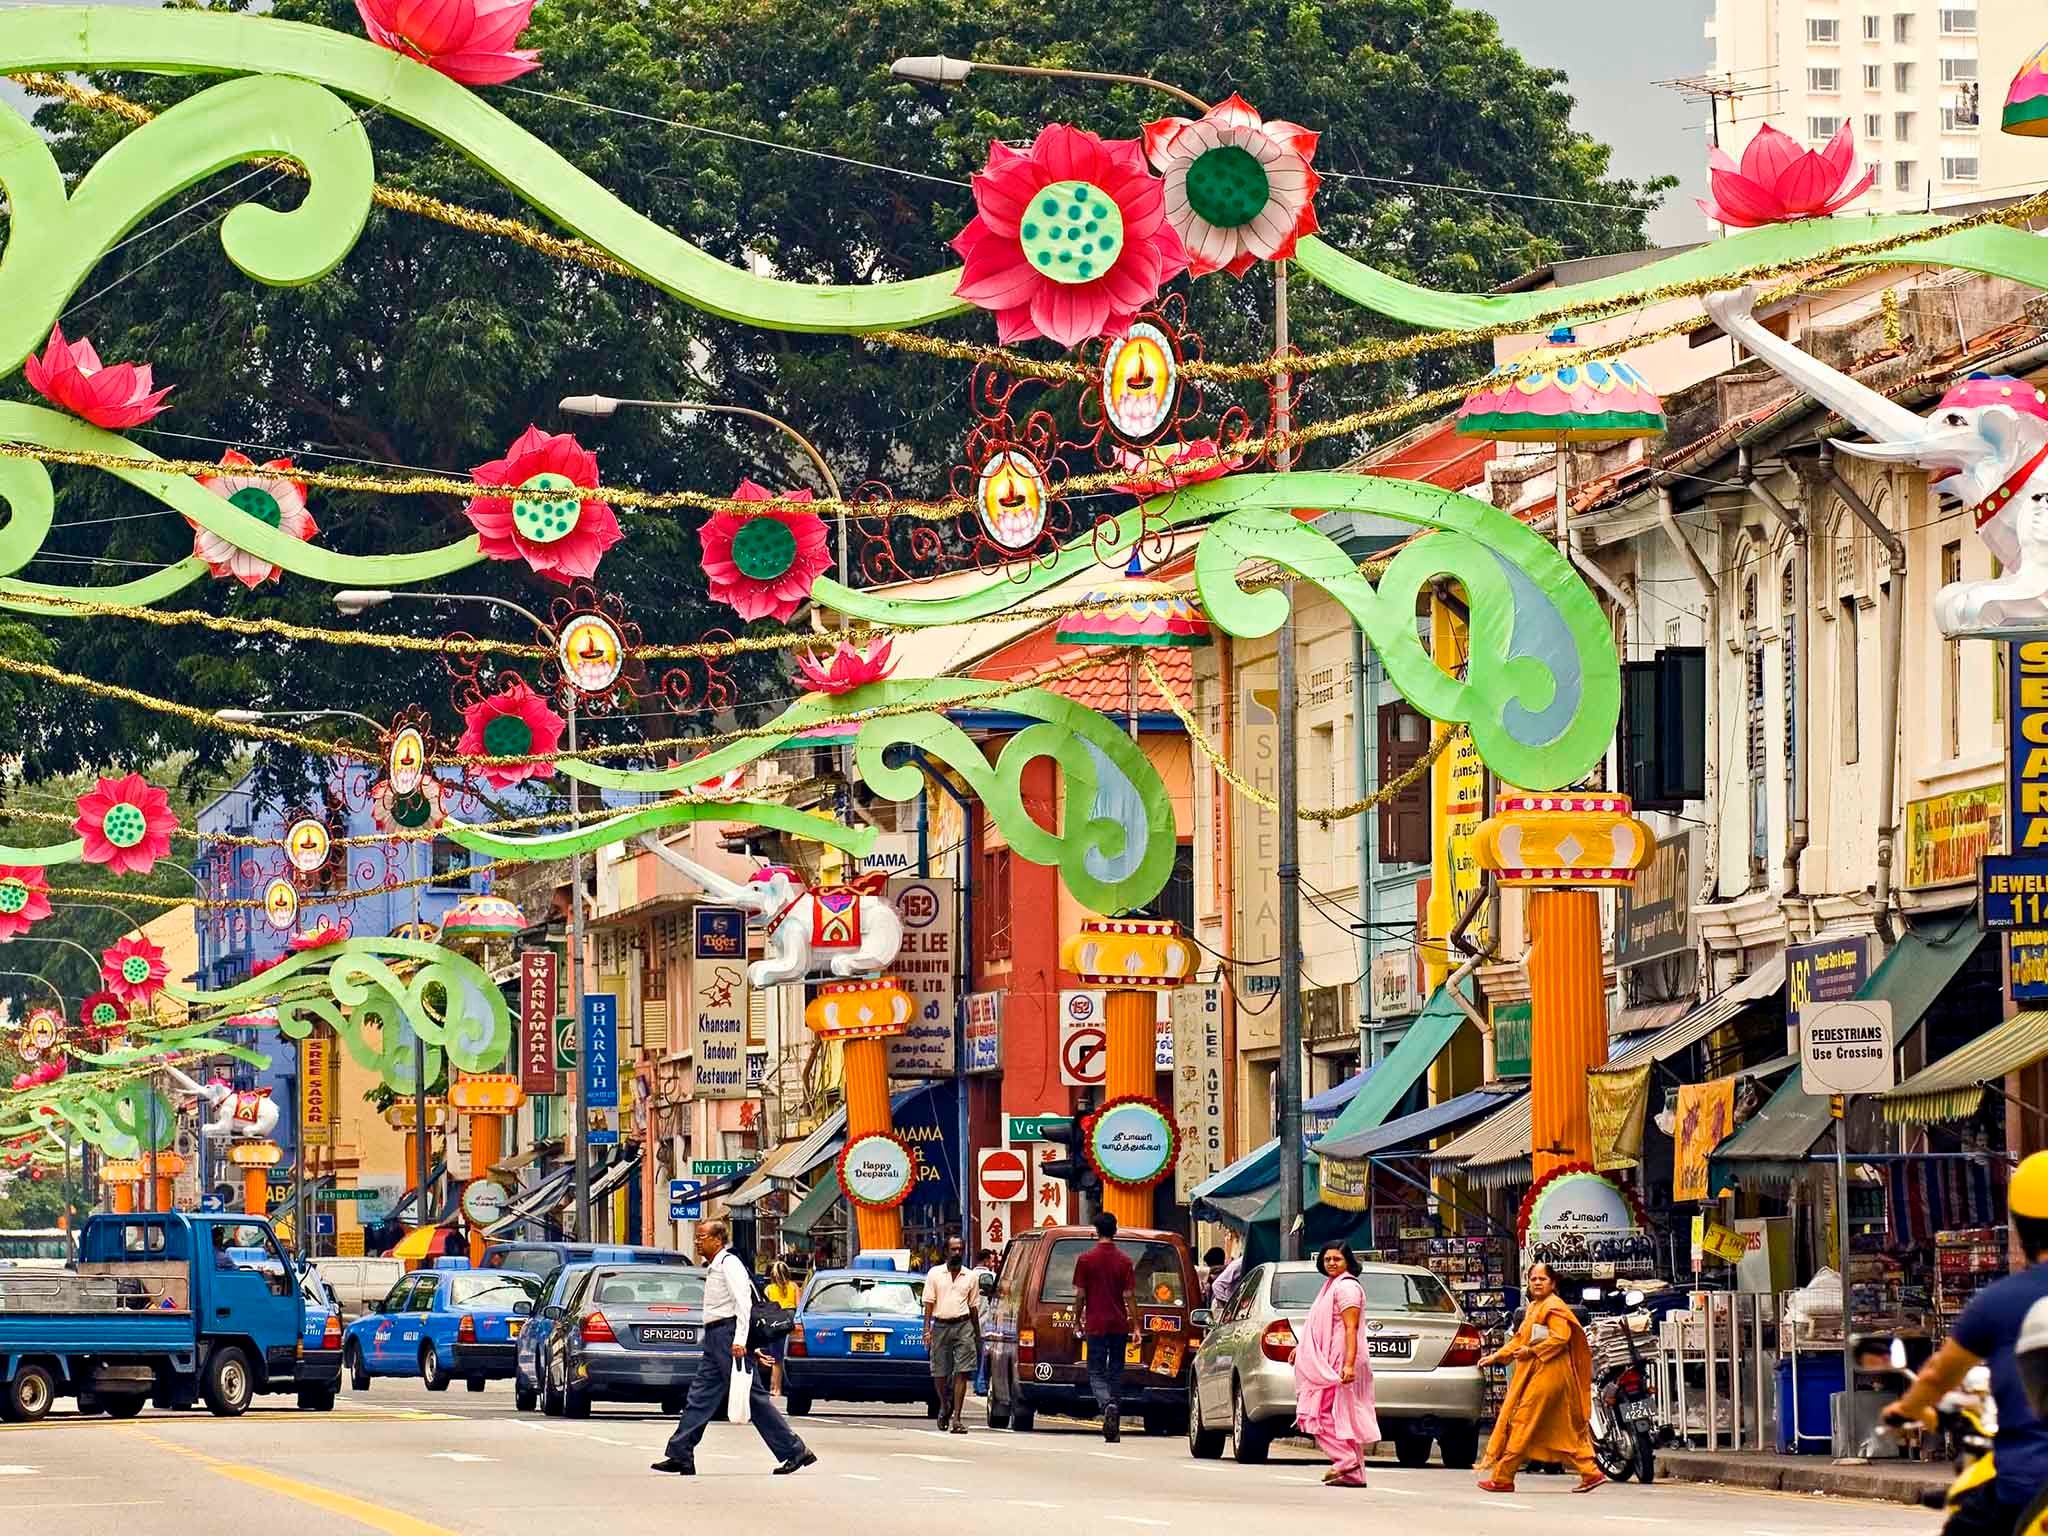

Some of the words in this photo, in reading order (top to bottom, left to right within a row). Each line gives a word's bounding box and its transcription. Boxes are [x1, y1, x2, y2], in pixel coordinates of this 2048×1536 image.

[1255, 735, 1277, 958] SHEETAL
[863, 854, 907, 867] MAMA
[1989, 875, 2048, 893] JEWEL
[902, 895, 932, 916] 152
[703, 934, 737, 951] Tiger
[922, 932, 948, 952] LEE
[923, 980, 946, 992] LTD.
[1790, 959, 1811, 1013] ABC
[1072, 1001, 1090, 1014] 152
[1205, 990, 1217, 1012] HO
[528, 957, 549, 1073] SWARNAMAHAL
[699, 1013, 741, 1032] Khansama
[1206, 1024, 1217, 1056] LEE
[1811, 1027, 1882, 1041] PEDESTRIANS
[592, 1002, 606, 1088] BHARATH
[703, 1040, 737, 1060] Tandoori
[1813, 1048, 1832, 1060] Use
[1836, 1046, 1883, 1059] Crossing
[309, 1042, 322, 1075] SREE
[697, 1065, 741, 1085] Restaurant
[1207, 1069, 1219, 1115] AUTO
[308, 1080, 323, 1123] SAGAR
[894, 1126, 944, 1141] MAMA
[913, 1146, 926, 1162] &
[695, 1163, 732, 1174] Norris
[855, 1169, 899, 1178] Deepavali
[863, 1161, 892, 1170] Happy
[916, 1166, 940, 1181] PA
[672, 1207, 685, 1215] ONE
[687, 1207, 699, 1215] WAY
[1557, 1210, 1608, 1222] தீபாவளி
[1038, 1364, 1050, 1375] 70
